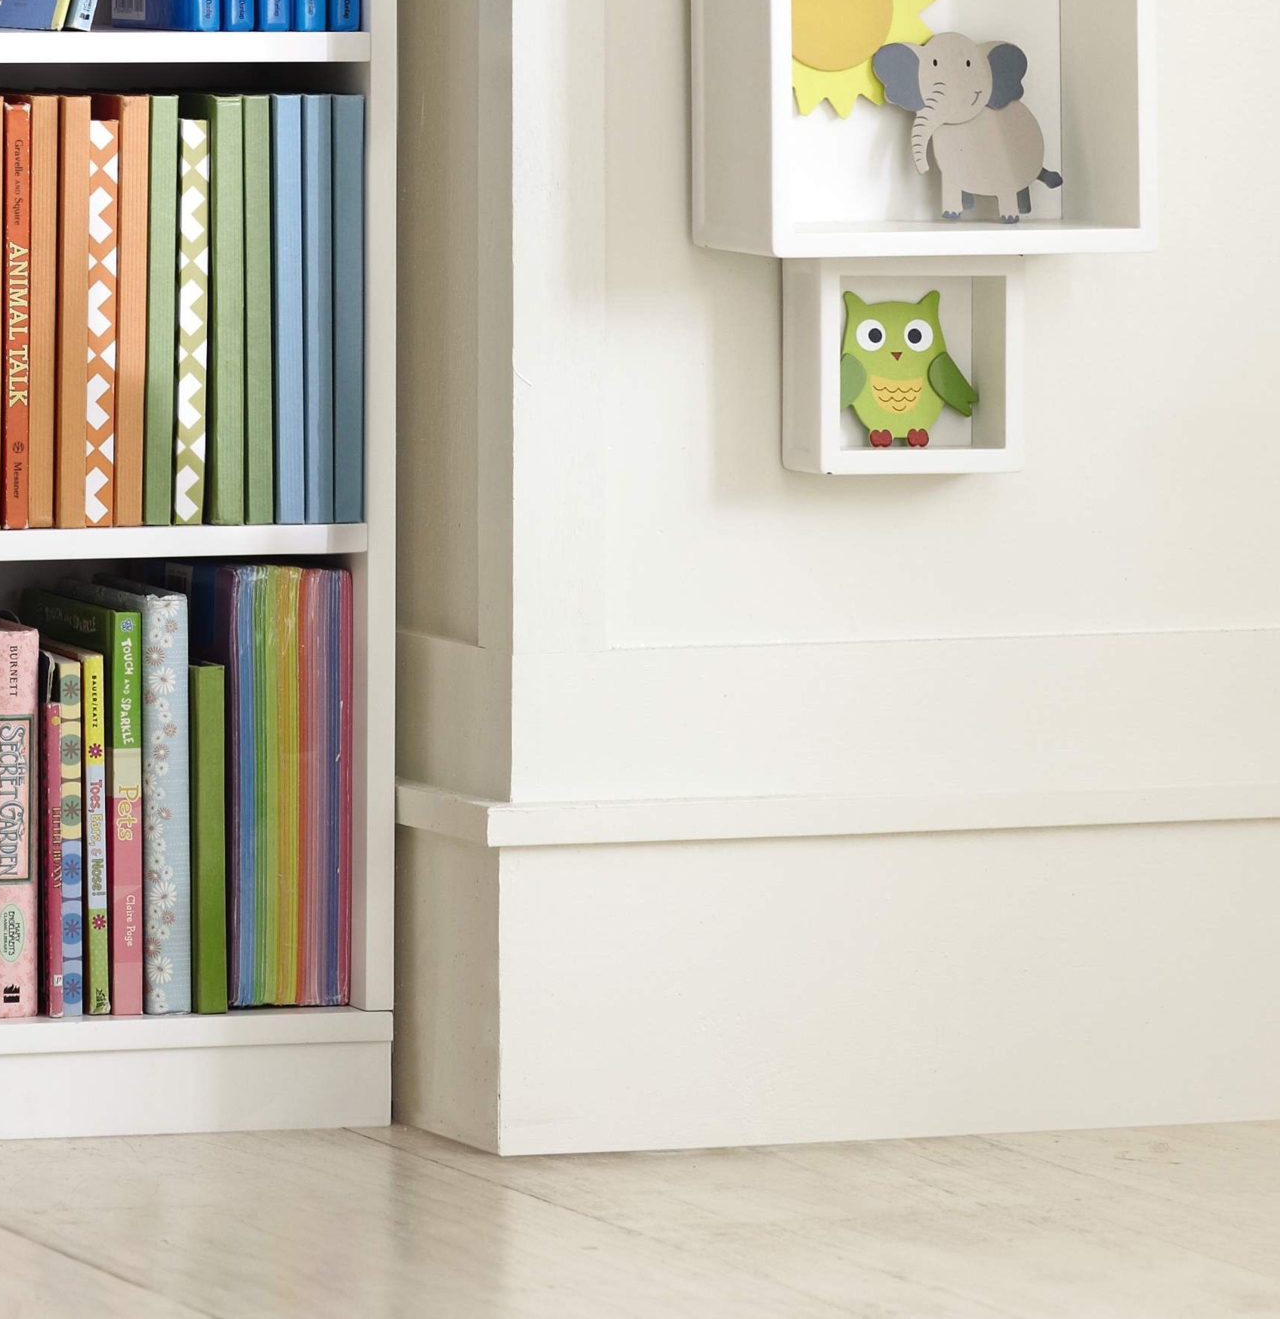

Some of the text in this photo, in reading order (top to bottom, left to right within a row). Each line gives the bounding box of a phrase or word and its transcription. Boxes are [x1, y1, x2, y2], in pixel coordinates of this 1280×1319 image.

[14, 139, 24, 177] Gravelle
[10, 197, 24, 226] Squire
[8, 241, 29, 408] ANIMAL TALK
[13, 462, 22, 500] Messner
[10, 646, 18, 696] BURNETT
[121, 638, 134, 676] TOUCH
[120, 697, 134, 745] SPARKLE
[117, 784, 140, 841] Pets
[88, 780, 106, 896] Toes, Ears, & Nose!
[124, 894, 136, 947] Claire Page
